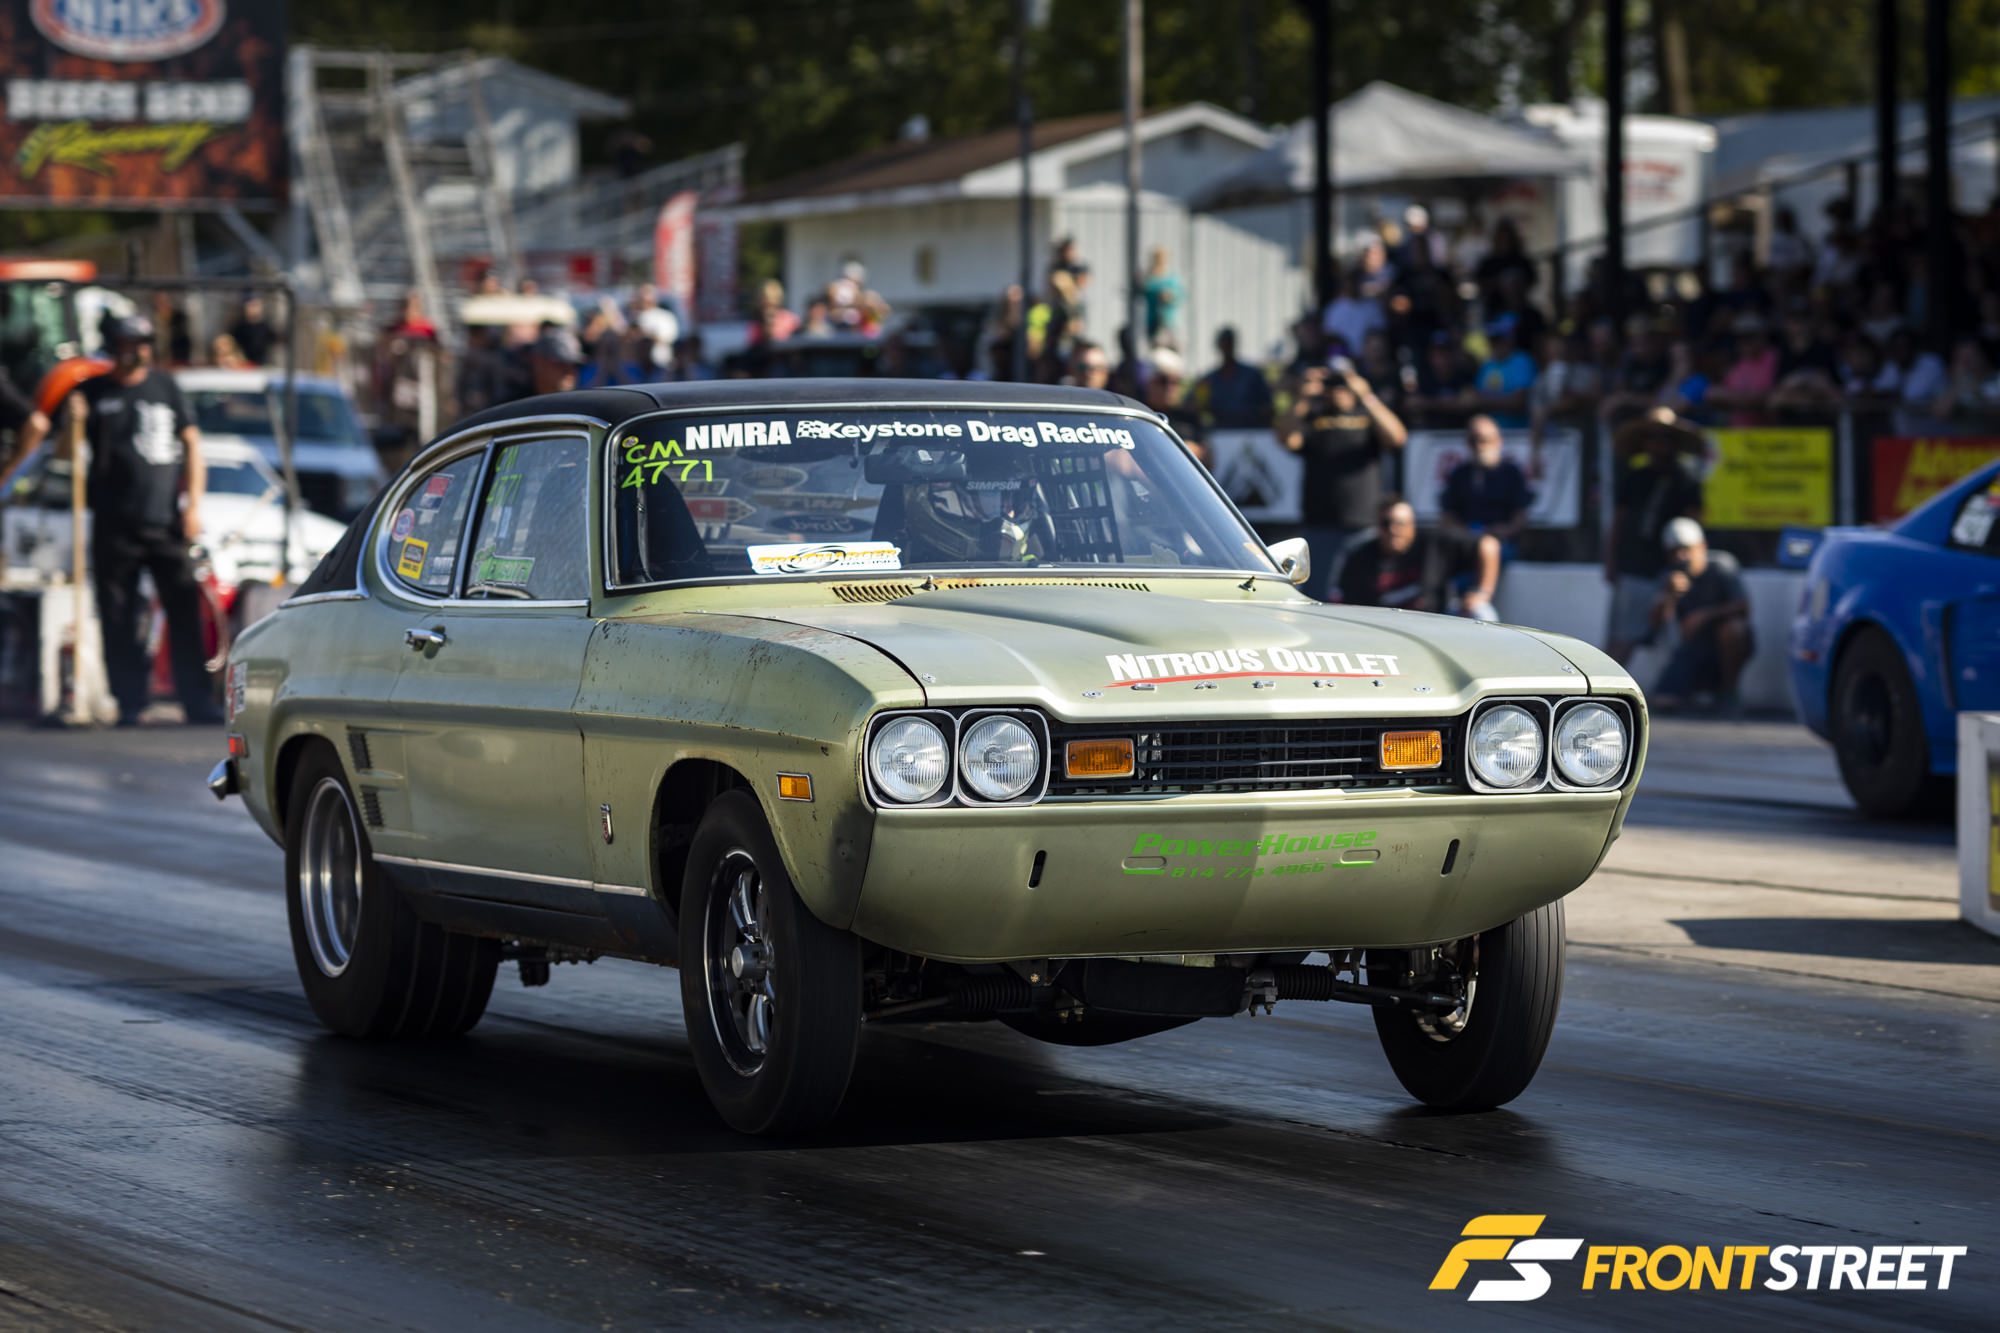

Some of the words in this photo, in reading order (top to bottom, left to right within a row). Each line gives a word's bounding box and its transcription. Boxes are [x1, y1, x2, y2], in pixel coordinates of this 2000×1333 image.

[686, 420, 792, 450] NMRA
[822, 421, 963, 442] Keystone
[966, 420, 1039, 448] Drag
[1037, 421, 1135, 450] Racing
[625, 440, 684, 463] CM
[621, 459, 713, 489] 4771
[966, 480, 1022, 490] SIMPSON
[1105, 648, 1265, 681] NITROUS
[1266, 647, 1400, 676] OUTLET
[1171, 867, 1215, 879] 814
[1224, 867, 1265, 879] 774
